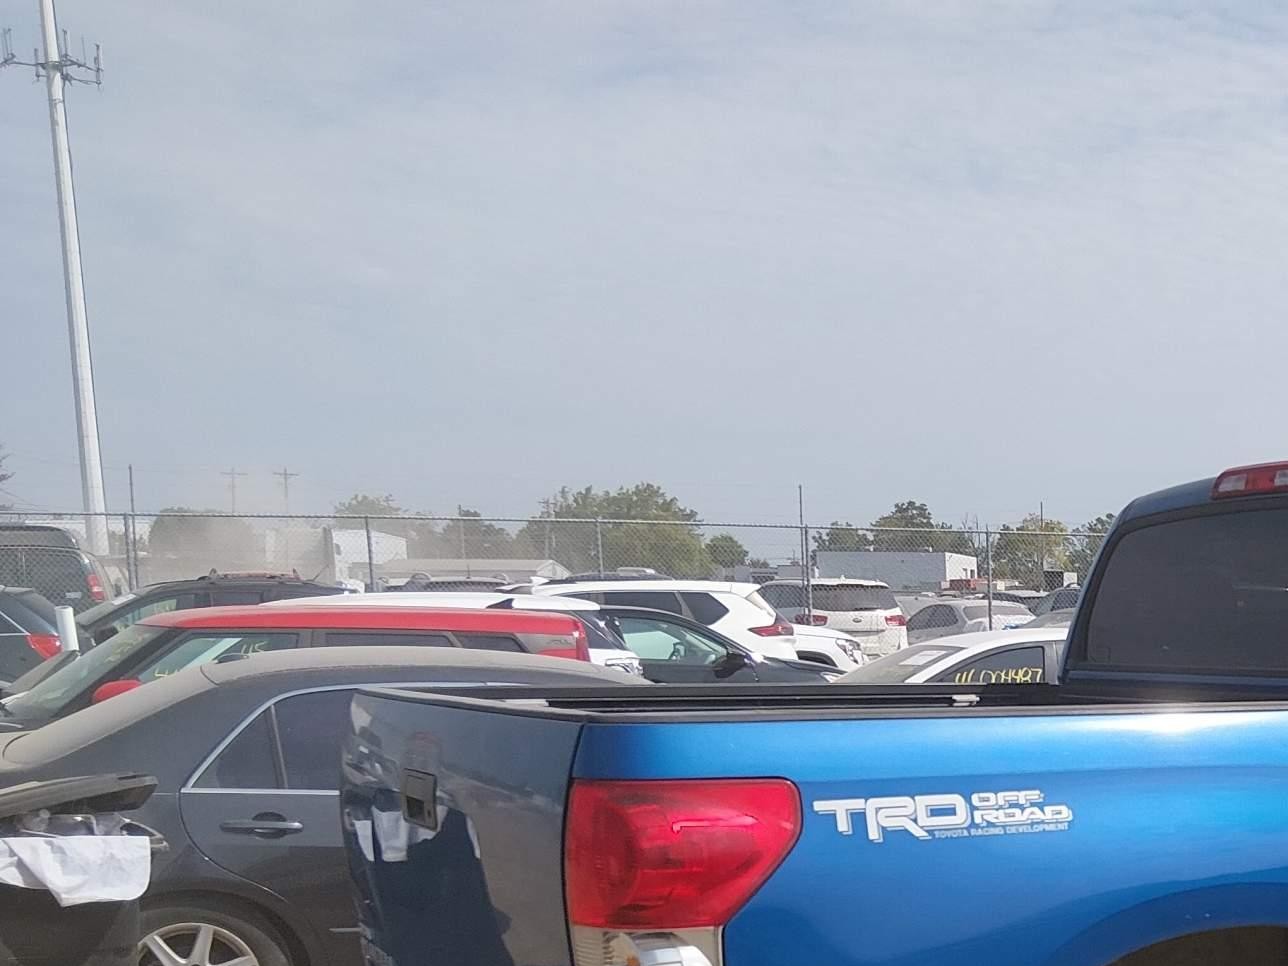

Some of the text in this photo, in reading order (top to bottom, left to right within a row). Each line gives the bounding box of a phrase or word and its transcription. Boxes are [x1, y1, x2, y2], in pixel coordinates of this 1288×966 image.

[971, 789, 1044, 809] OFF
[812, 794, 972, 844] TRD
[973, 804, 1073, 828] ROAD
[934, 821, 1070, 839] TOYOTA RACING DEVELOPMENT
